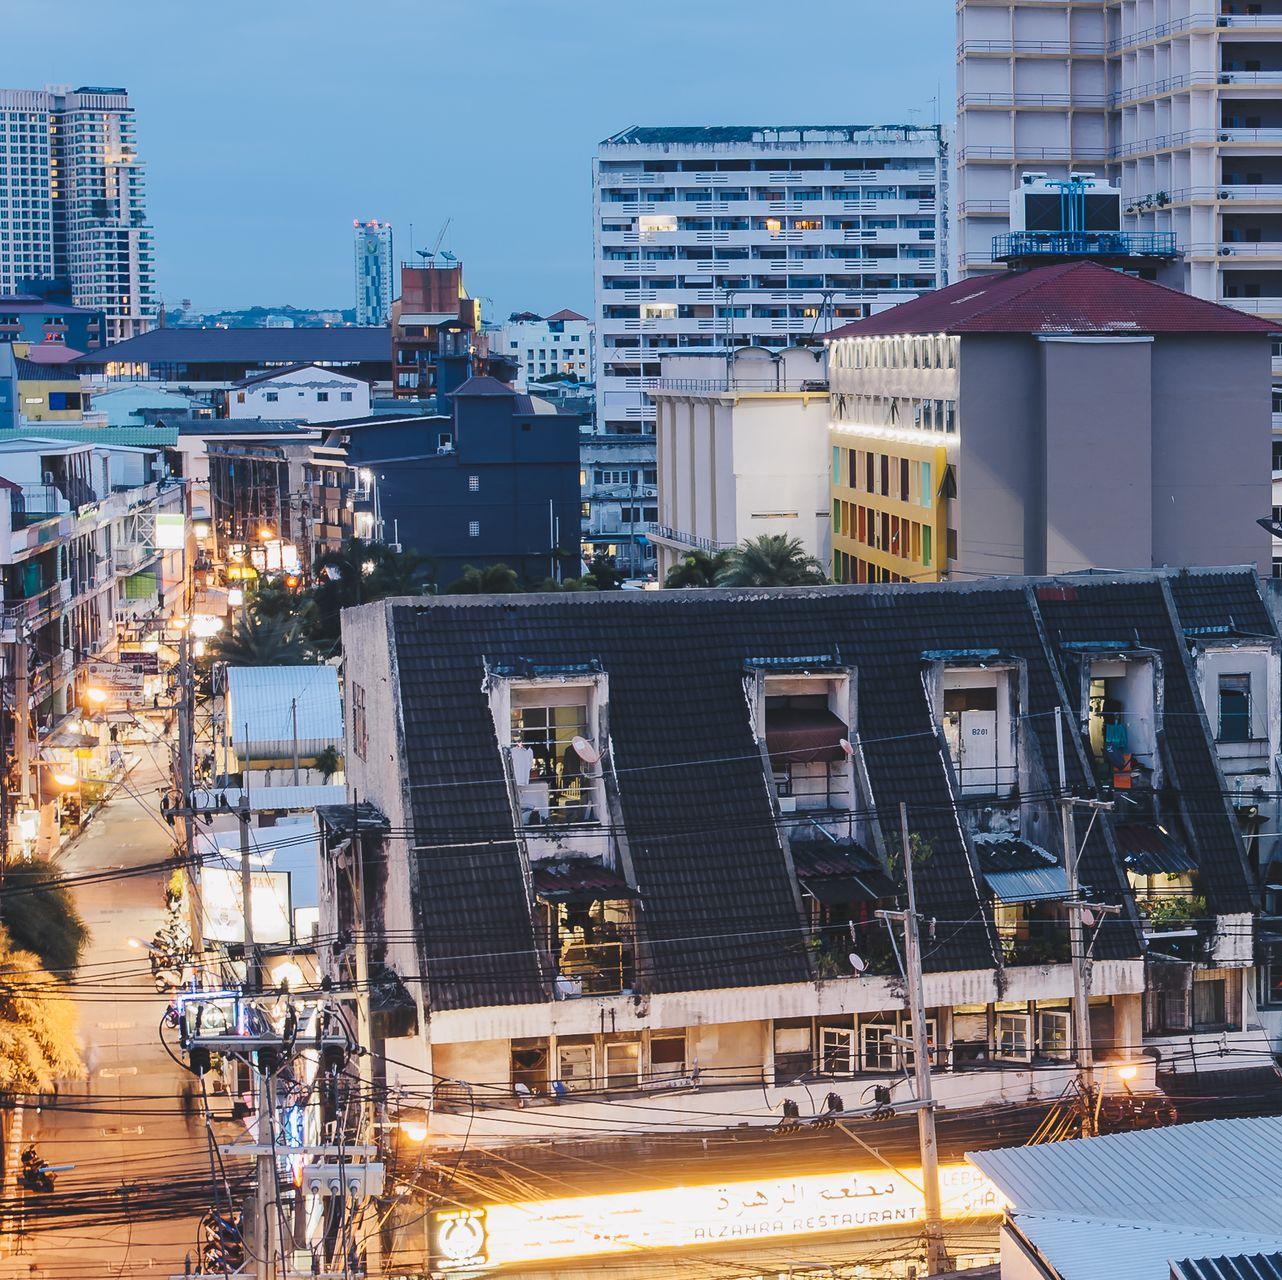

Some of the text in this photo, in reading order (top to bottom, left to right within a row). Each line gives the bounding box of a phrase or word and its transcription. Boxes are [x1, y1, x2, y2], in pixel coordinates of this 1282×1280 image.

[943, 1170, 984, 1187] LEBA
[717, 1178, 895, 1217] مطعم الزهرة
[962, 1188, 996, 1211] SHA
[694, 1207, 917, 1239] ALZAHRA RESTAURANT
